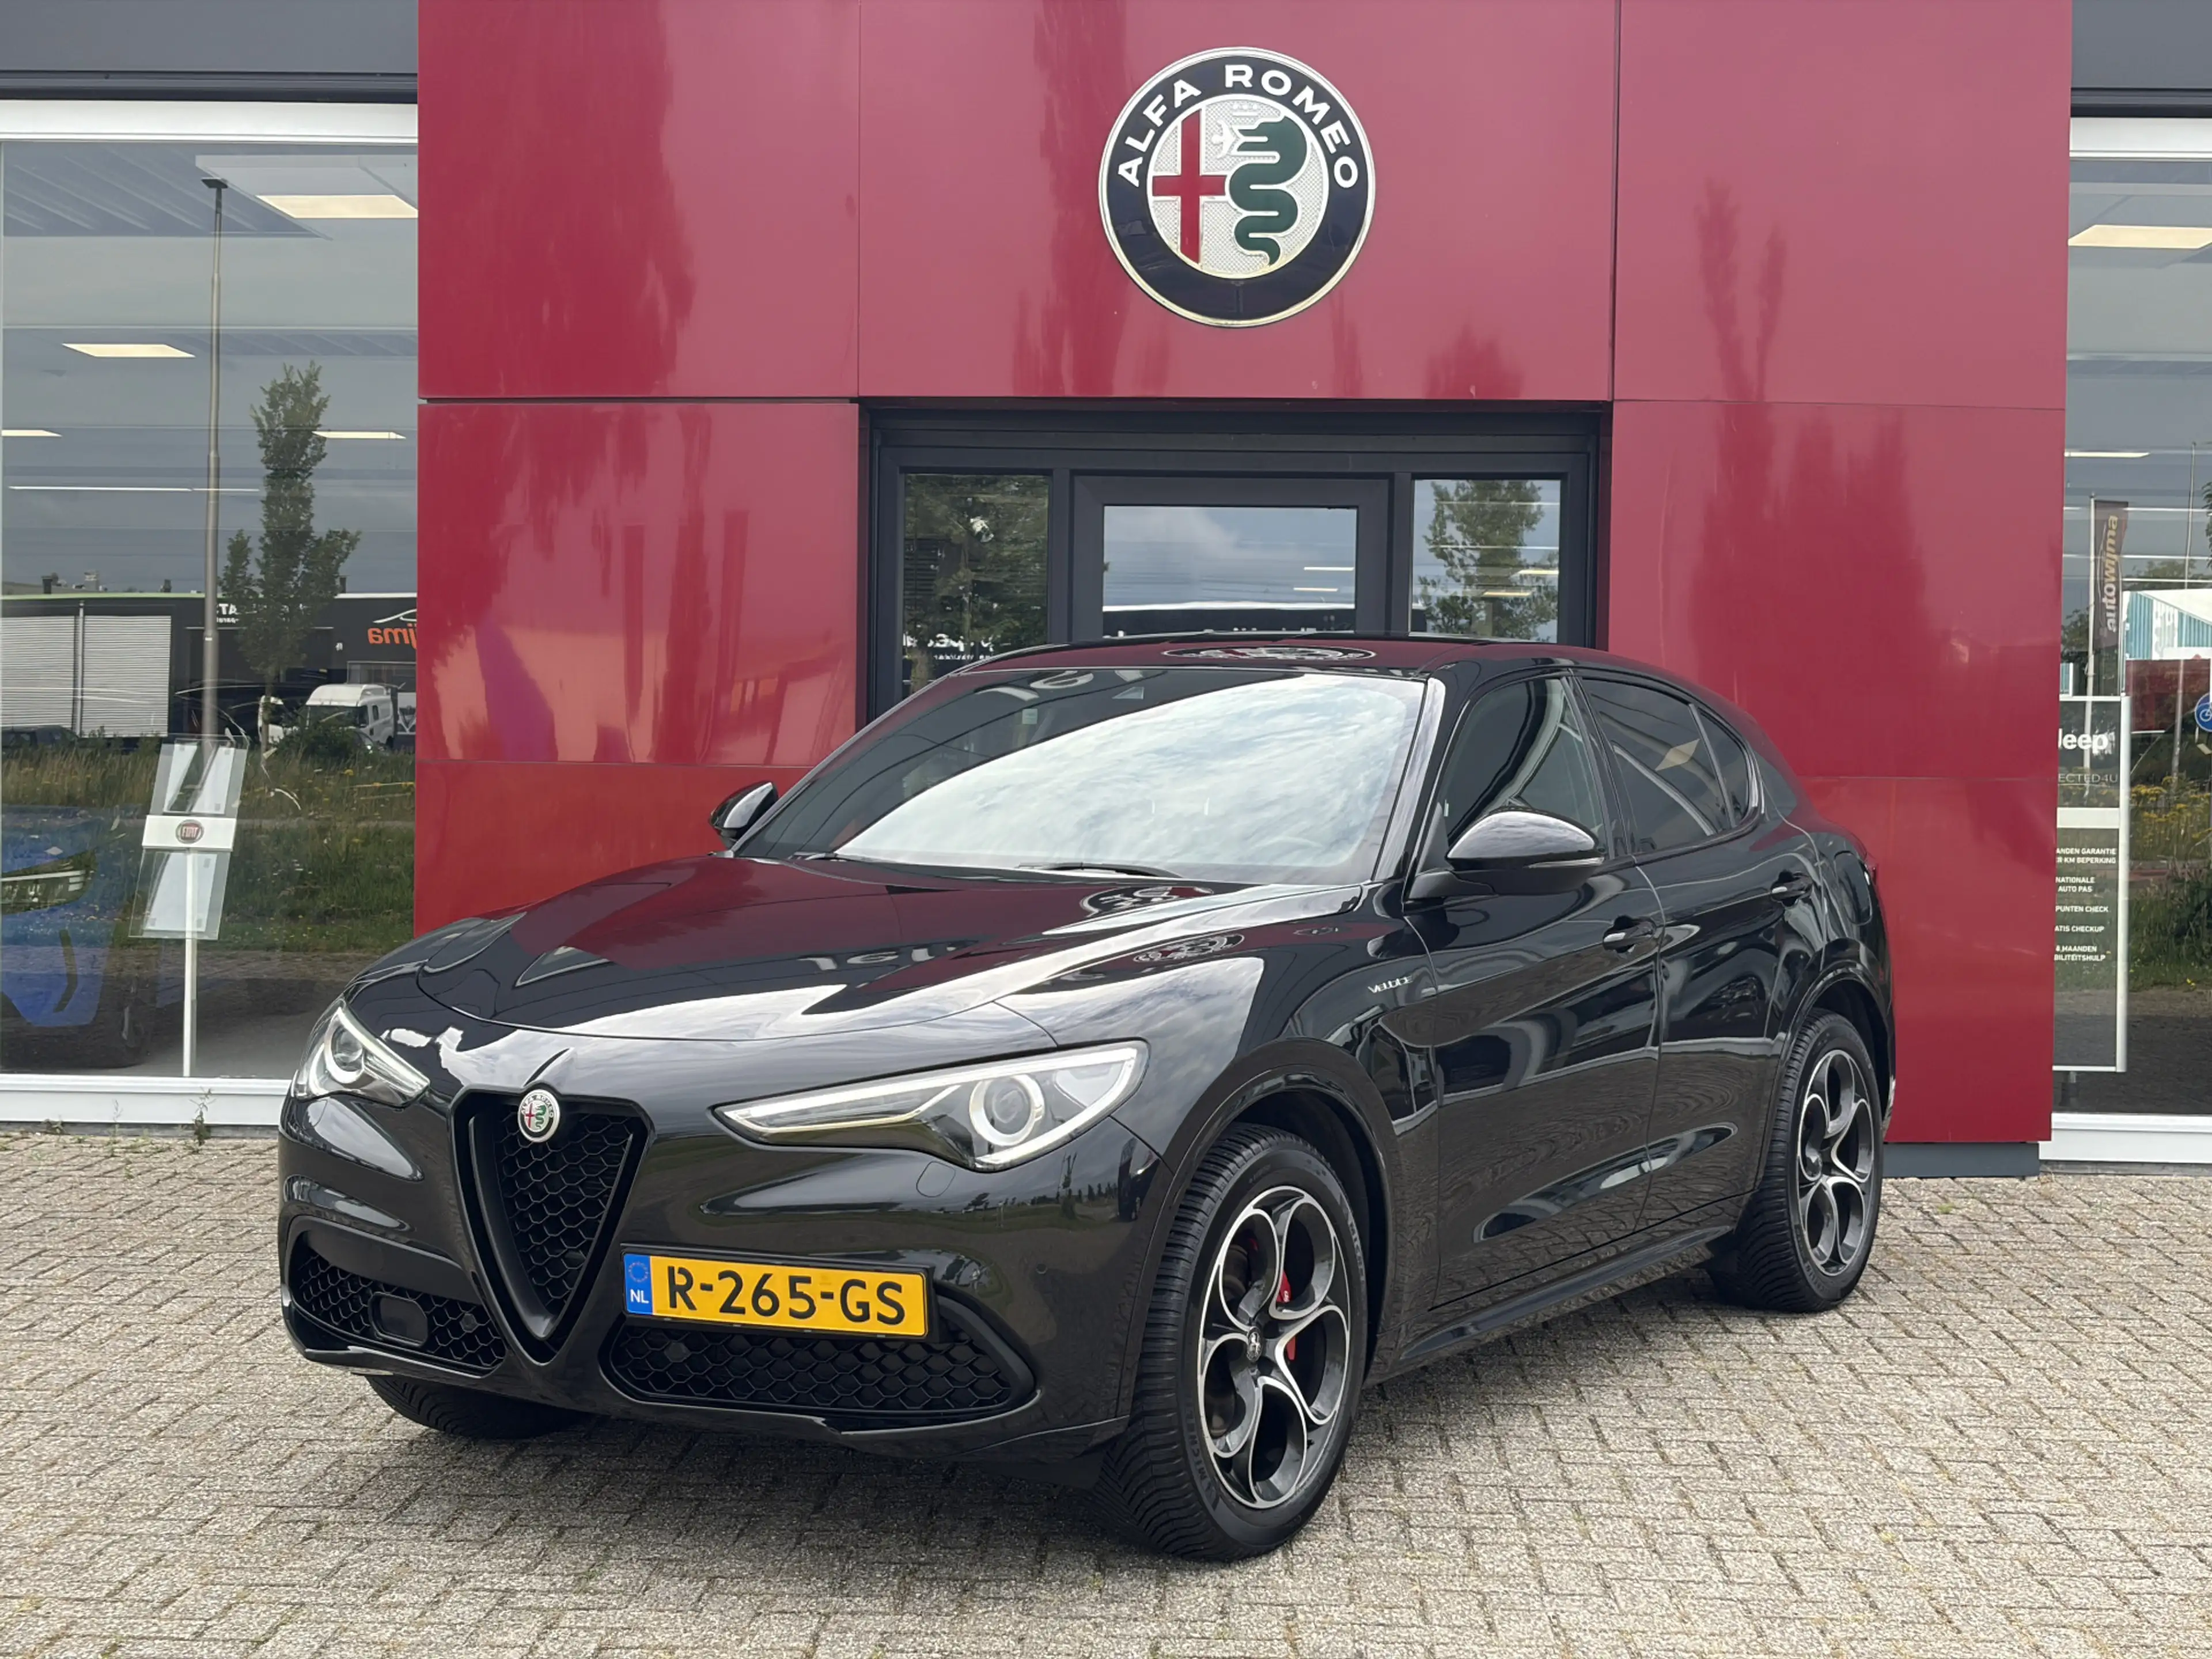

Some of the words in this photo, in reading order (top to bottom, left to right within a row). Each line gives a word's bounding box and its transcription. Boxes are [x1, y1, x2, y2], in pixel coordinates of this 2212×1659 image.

[1118, 79, 1201, 187] ALFA
[1225, 64, 1359, 188] ROMEO
[630, 1289, 650, 1304] NL
[667, 1265, 906, 1325] R-265-GS
